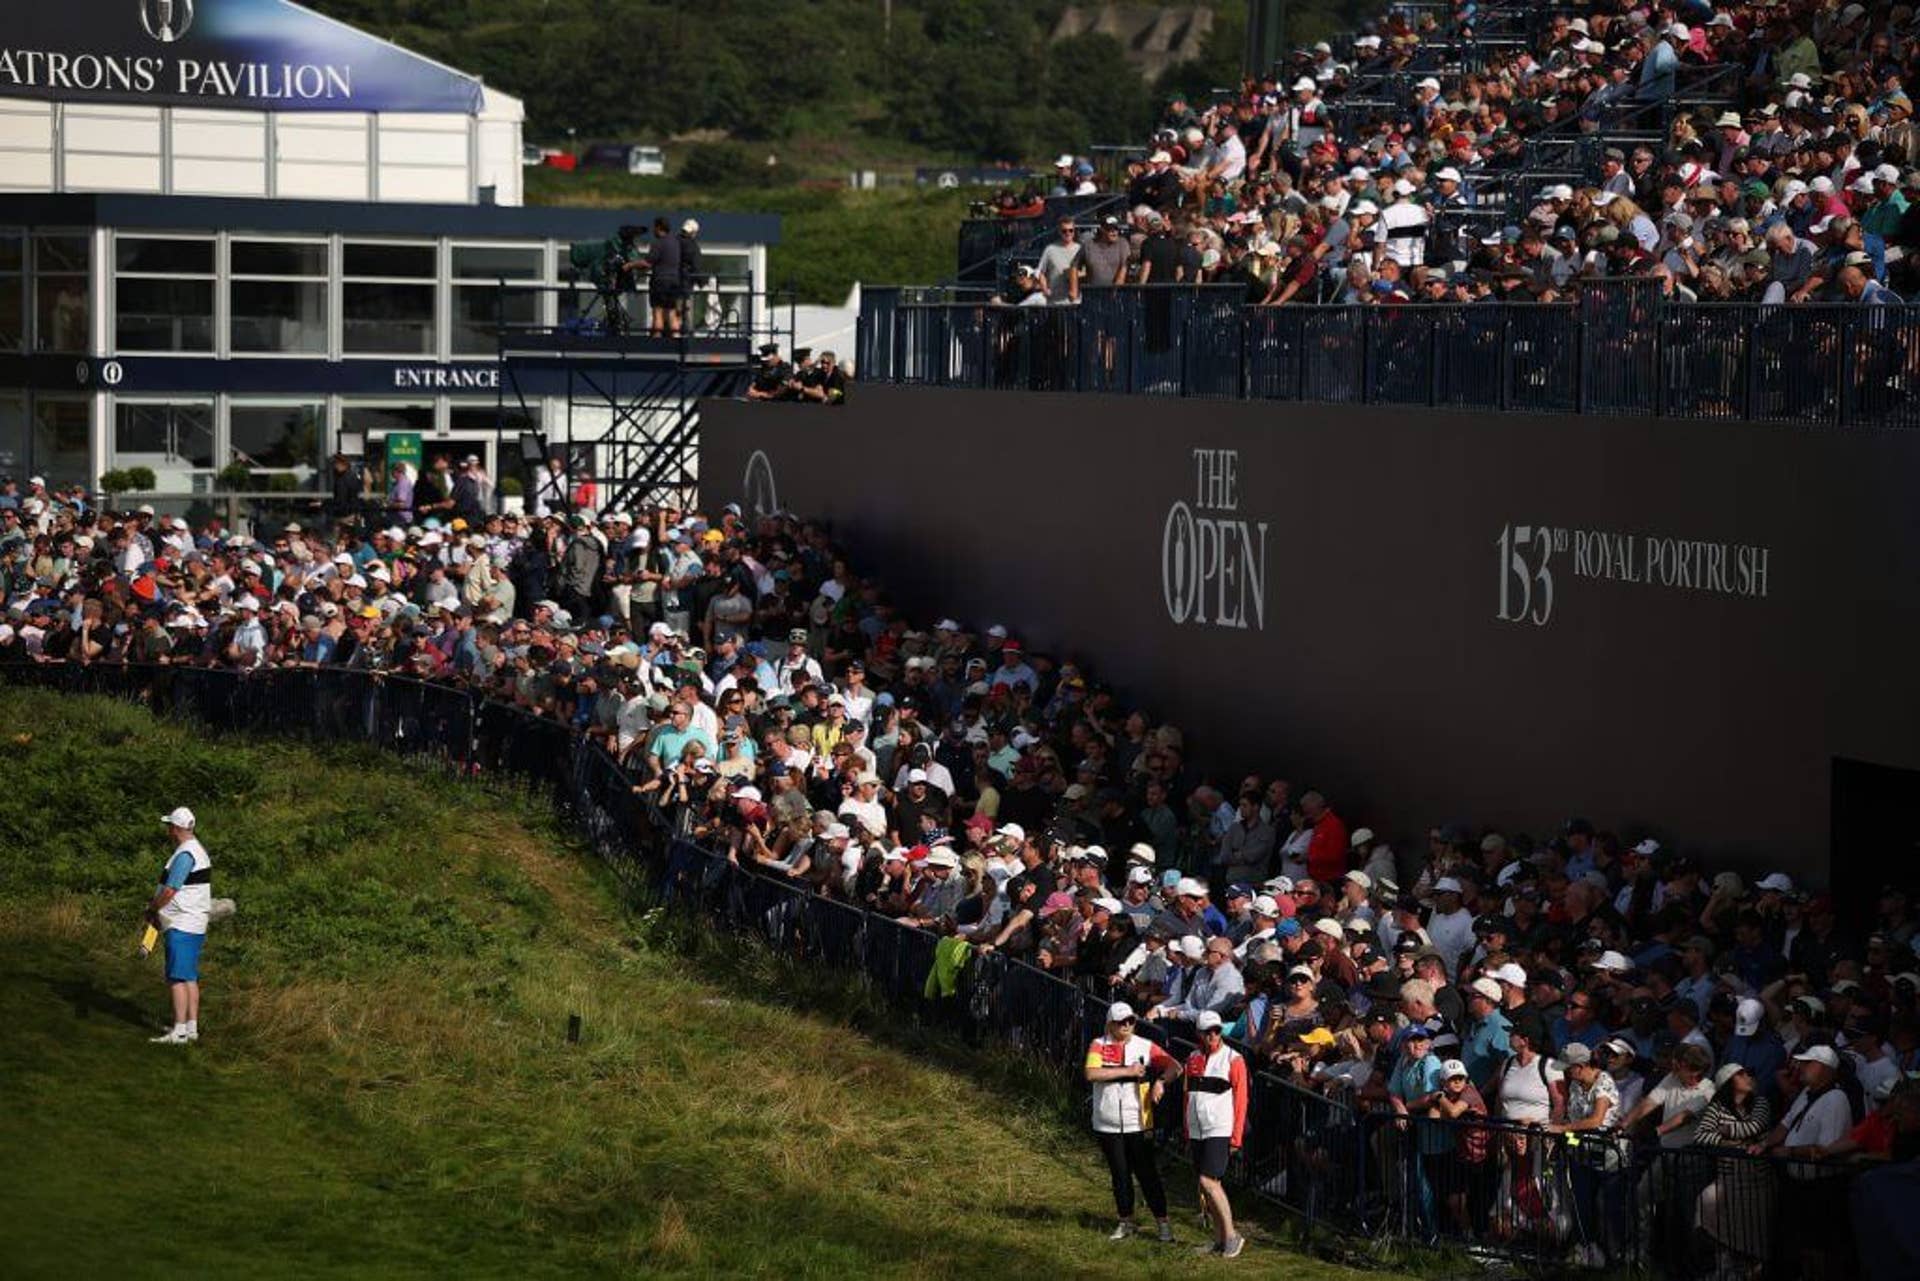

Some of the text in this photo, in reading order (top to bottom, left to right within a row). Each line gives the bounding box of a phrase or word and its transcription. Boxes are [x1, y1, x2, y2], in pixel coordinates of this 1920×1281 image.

[177, 59, 351, 98] PAVILION
[395, 368, 500, 387] ENTRANCE
[1193, 448, 1239, 510] THE
[1162, 501, 1268, 630] OPEN
[1574, 529, 1640, 582] ROYAL
[1646, 537, 1769, 597] PORTRUSH
